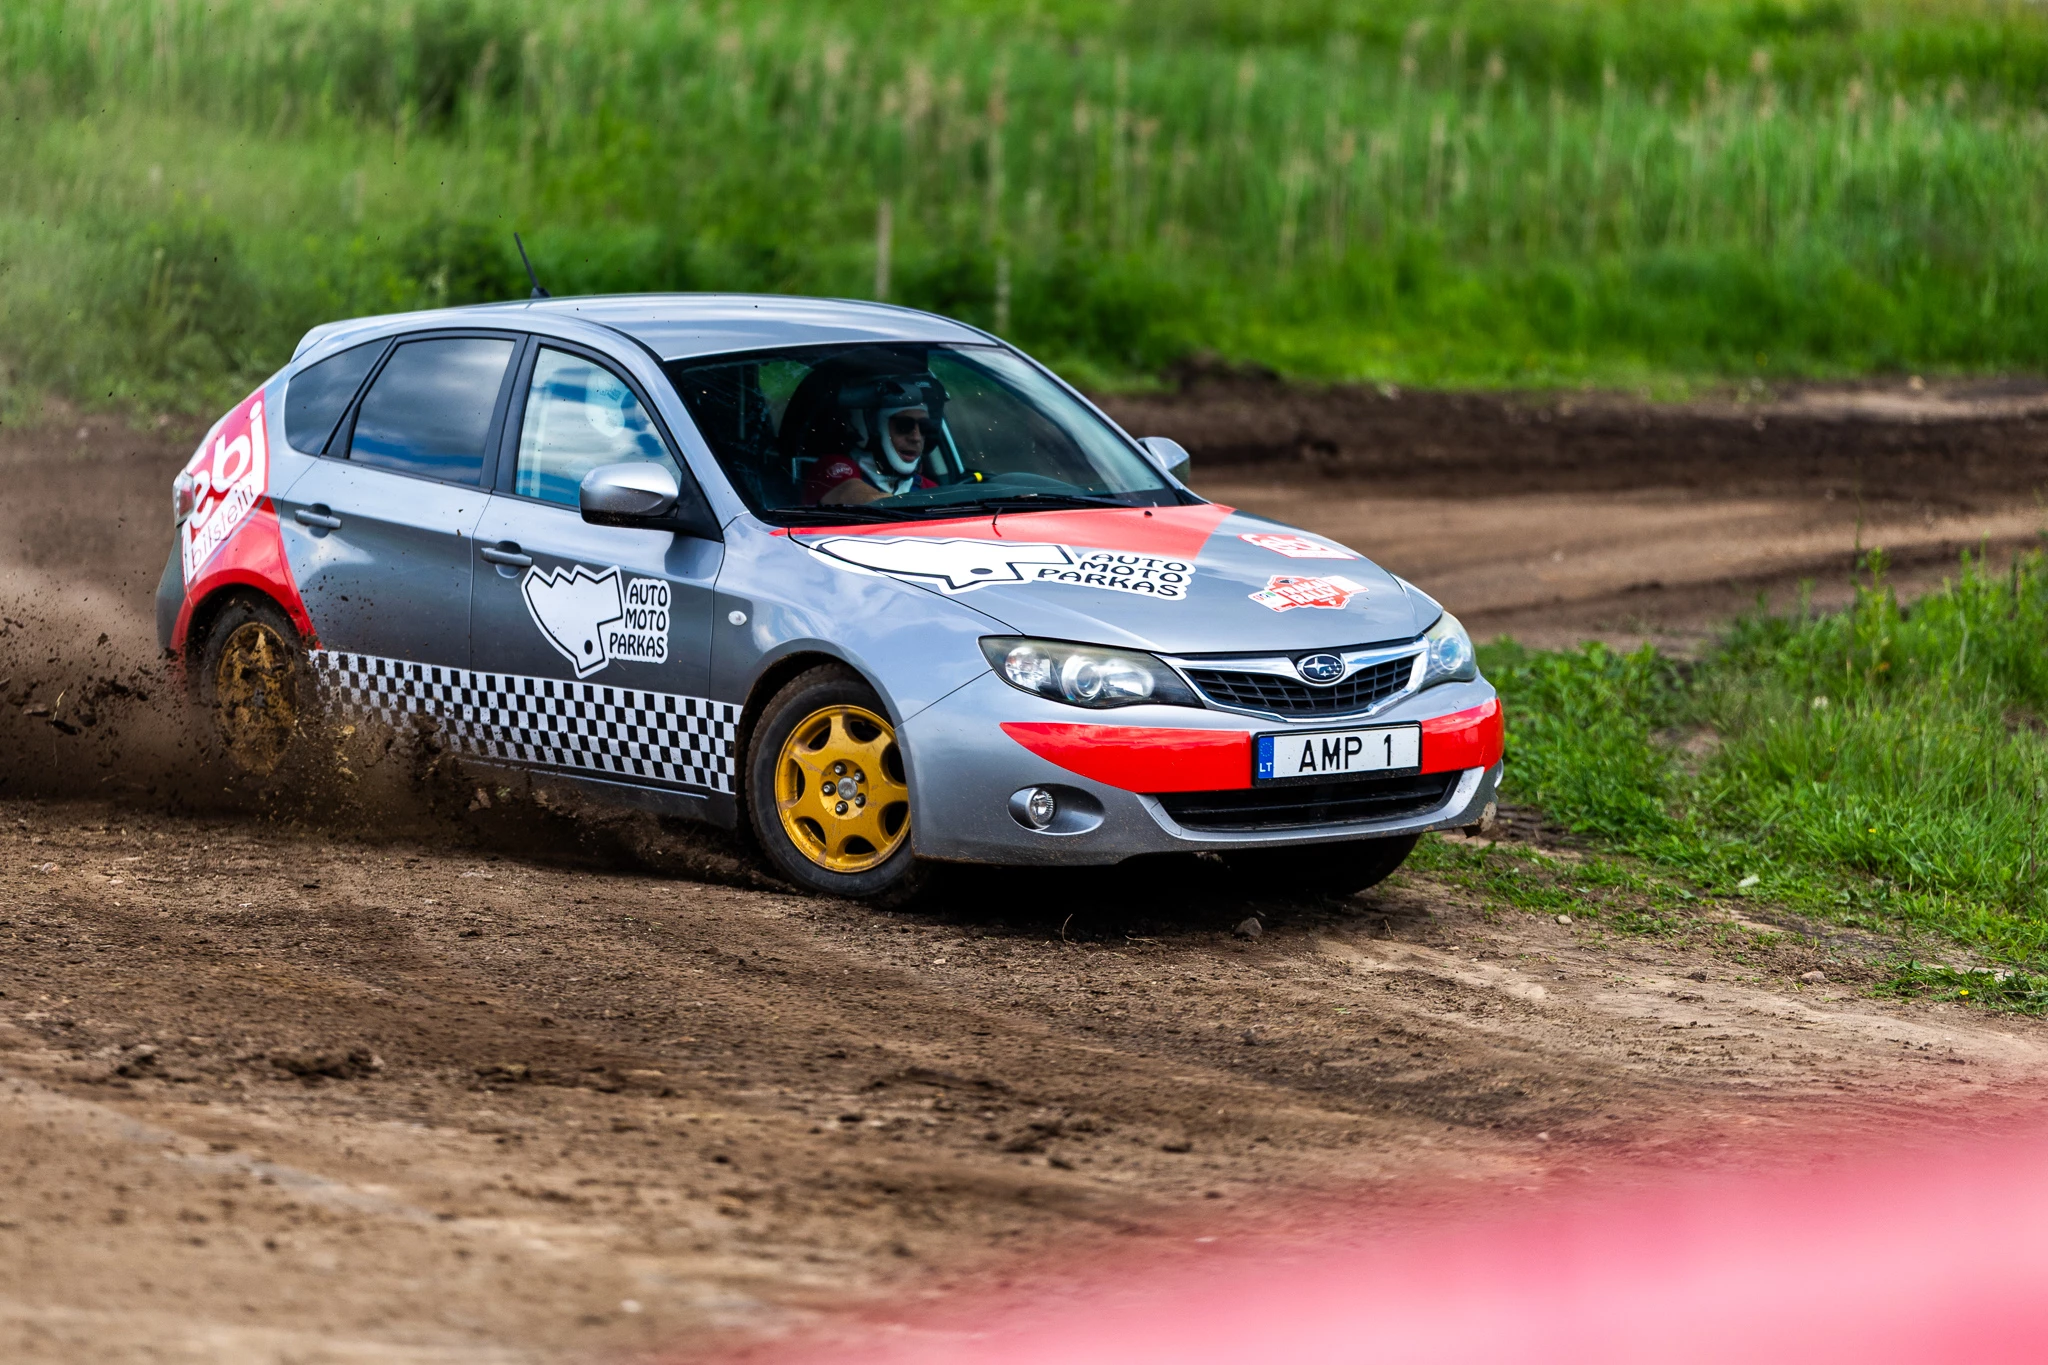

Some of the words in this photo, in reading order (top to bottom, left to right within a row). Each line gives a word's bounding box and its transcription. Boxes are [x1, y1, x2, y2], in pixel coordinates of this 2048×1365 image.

[191, 484, 254, 566] bilstein
[1079, 561, 1184, 584] MOTO
[1090, 553, 1188, 572] AUTO
[629, 583, 668, 607] AUTO
[1037, 568, 1179, 597] PARKAS
[624, 607, 667, 632] MOTO
[609, 632, 665, 658] PARKAS
[1298, 736, 1363, 772] AMP
[1383, 734, 1392, 767] 1
[1259, 762, 1273, 772] LT
